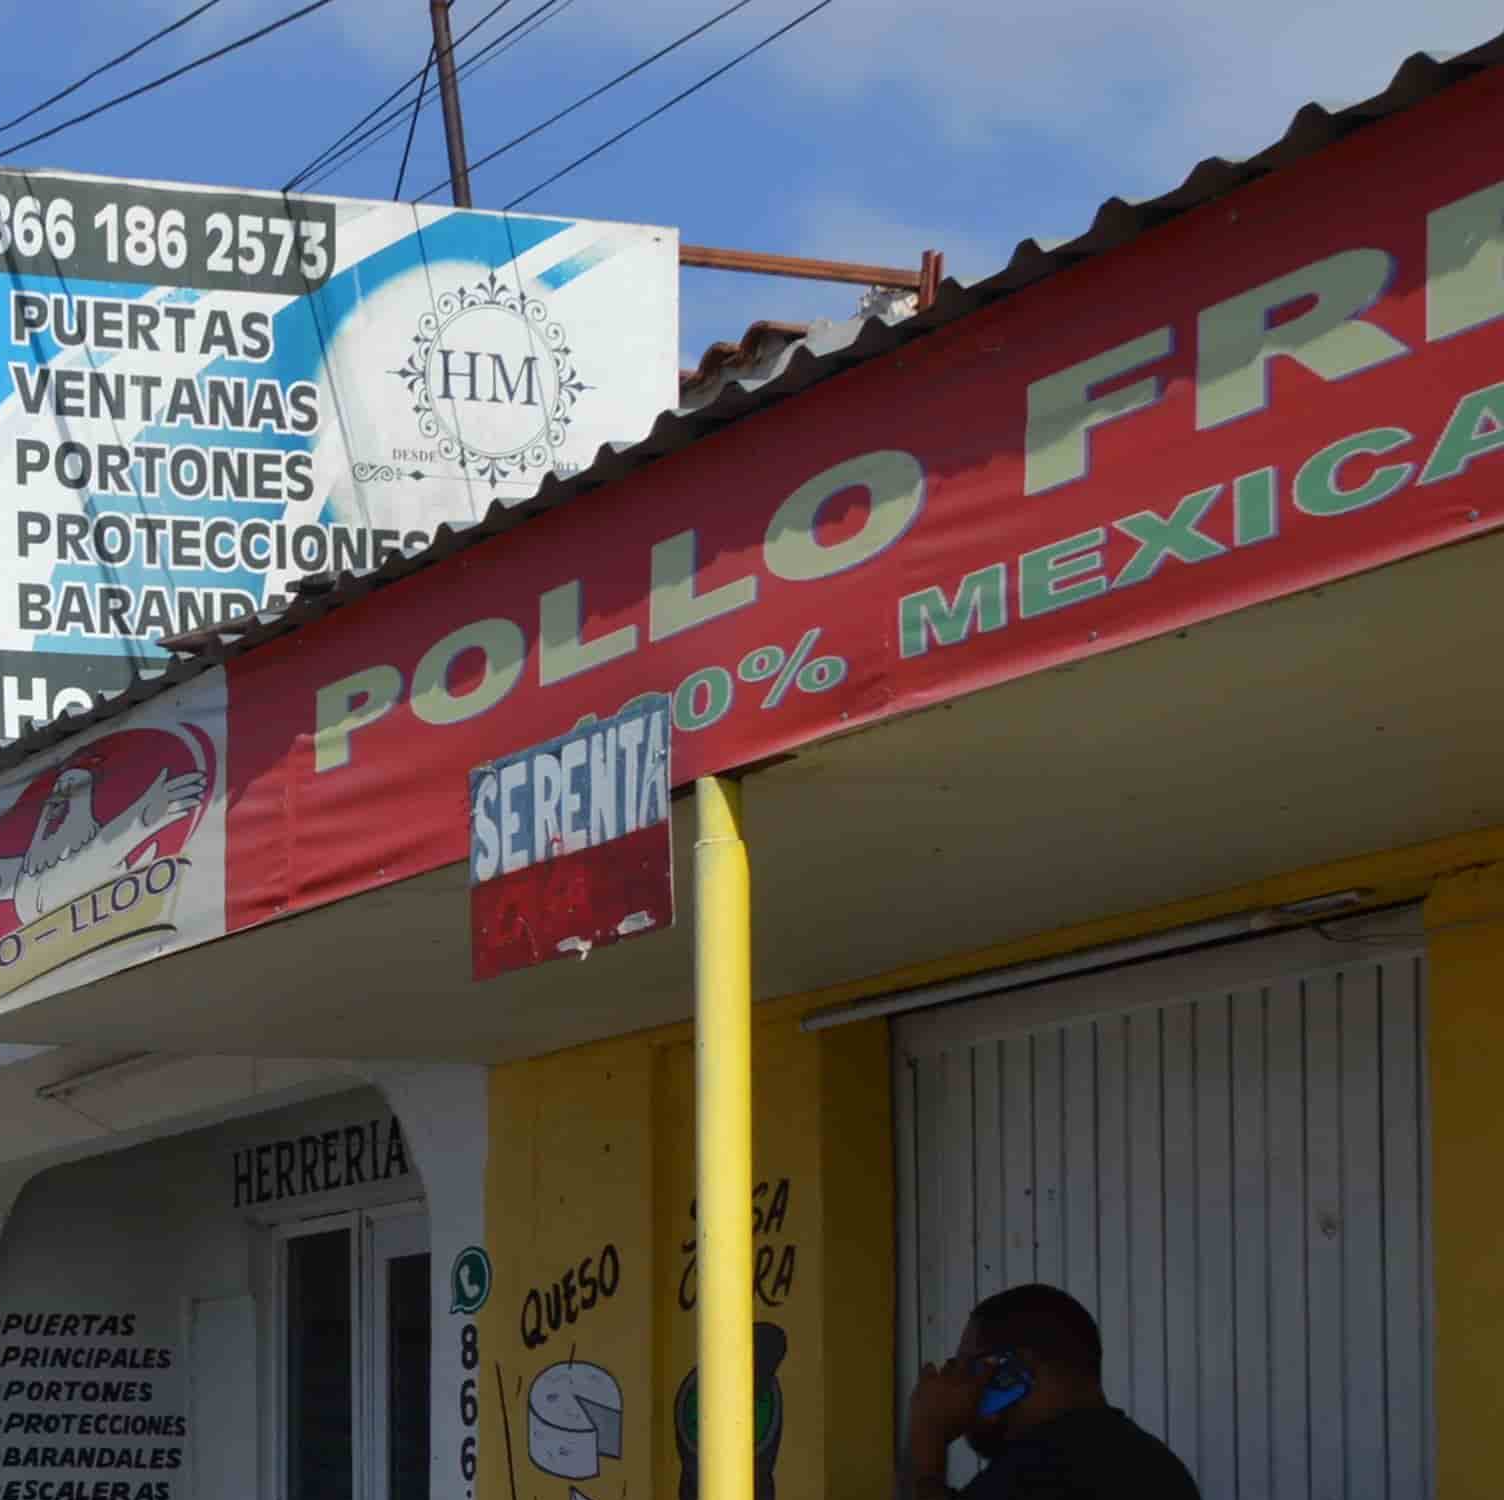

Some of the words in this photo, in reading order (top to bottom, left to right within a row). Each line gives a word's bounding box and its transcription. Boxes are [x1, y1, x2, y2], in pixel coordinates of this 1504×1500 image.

[93, 202, 188, 269] 186
[204, 212, 328, 280] 2573
[12, 293, 271, 359] PUERTAS
[11, 366, 319, 432] VENTANAS
[437, 348, 540, 406] HM
[16, 438, 315, 501] PORTONES
[312, 448, 928, 774] POLLO
[232, 1114, 410, 1209] HERRERIA
[0, 1313, 136, 1337] PUERTAS
[519, 1242, 622, 1351] QUESO
[0, 1345, 173, 1370] PRINCIPALES
[2, 1379, 153, 1402] PORTONES
[2, 1412, 188, 1437] PROTECCIONES
[2, 1446, 183, 1470] BARANDALES
